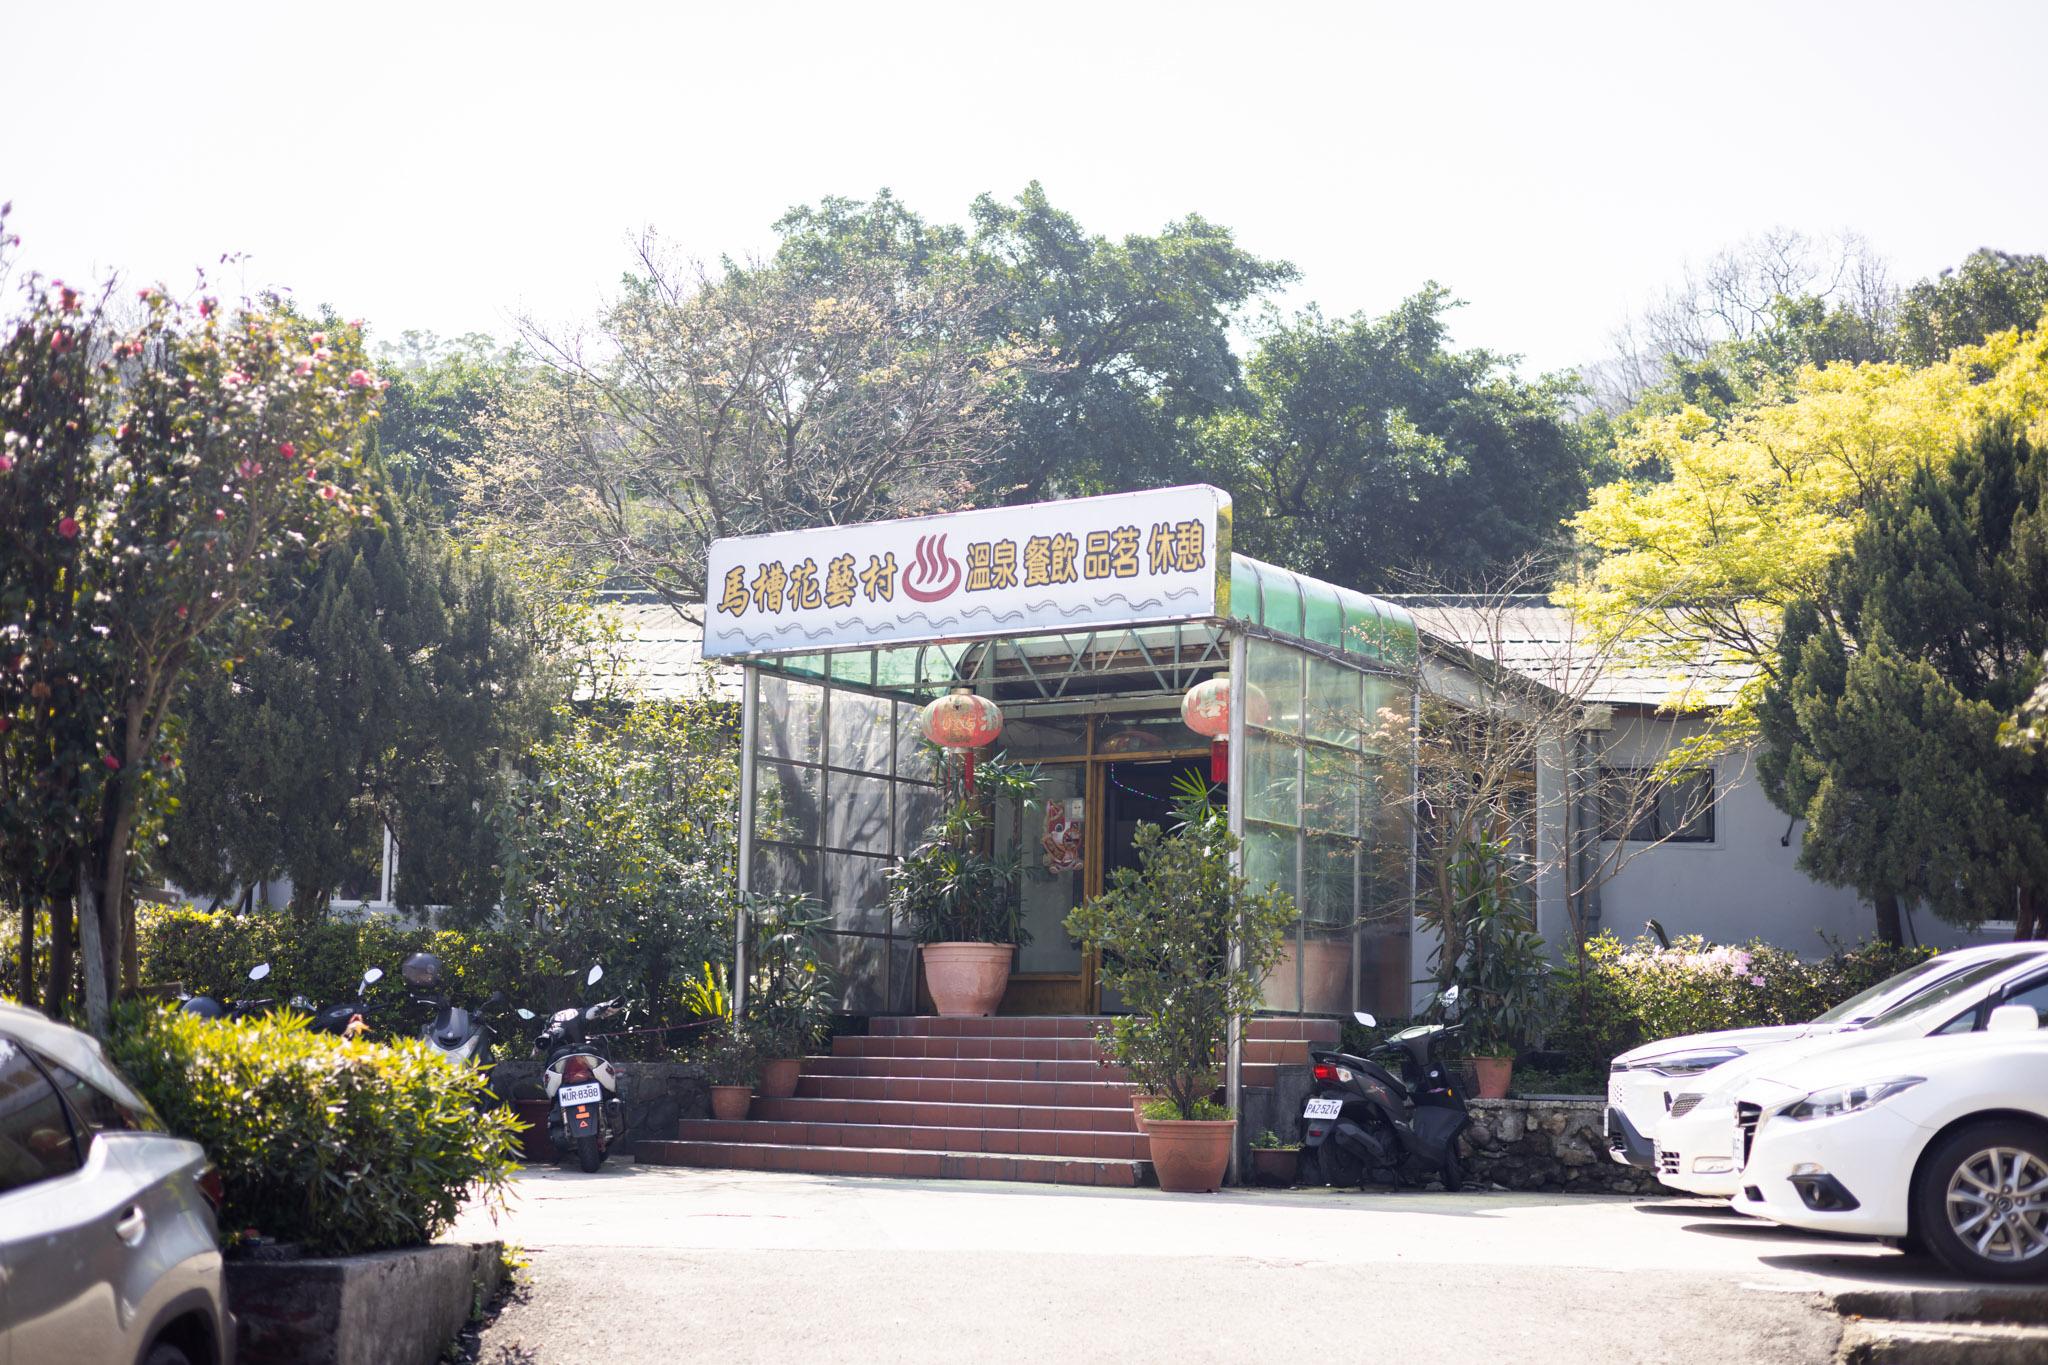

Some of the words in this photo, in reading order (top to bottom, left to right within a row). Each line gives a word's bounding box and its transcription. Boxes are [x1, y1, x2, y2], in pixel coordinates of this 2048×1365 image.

[717, 551, 898, 618] 馬槽花藝村
[965, 539, 1018, 593] 溫泉
[1024, 532, 1079, 588] 餐飲
[1084, 524, 1141, 580] 品茗
[1147, 519, 1205, 575] 休憩
